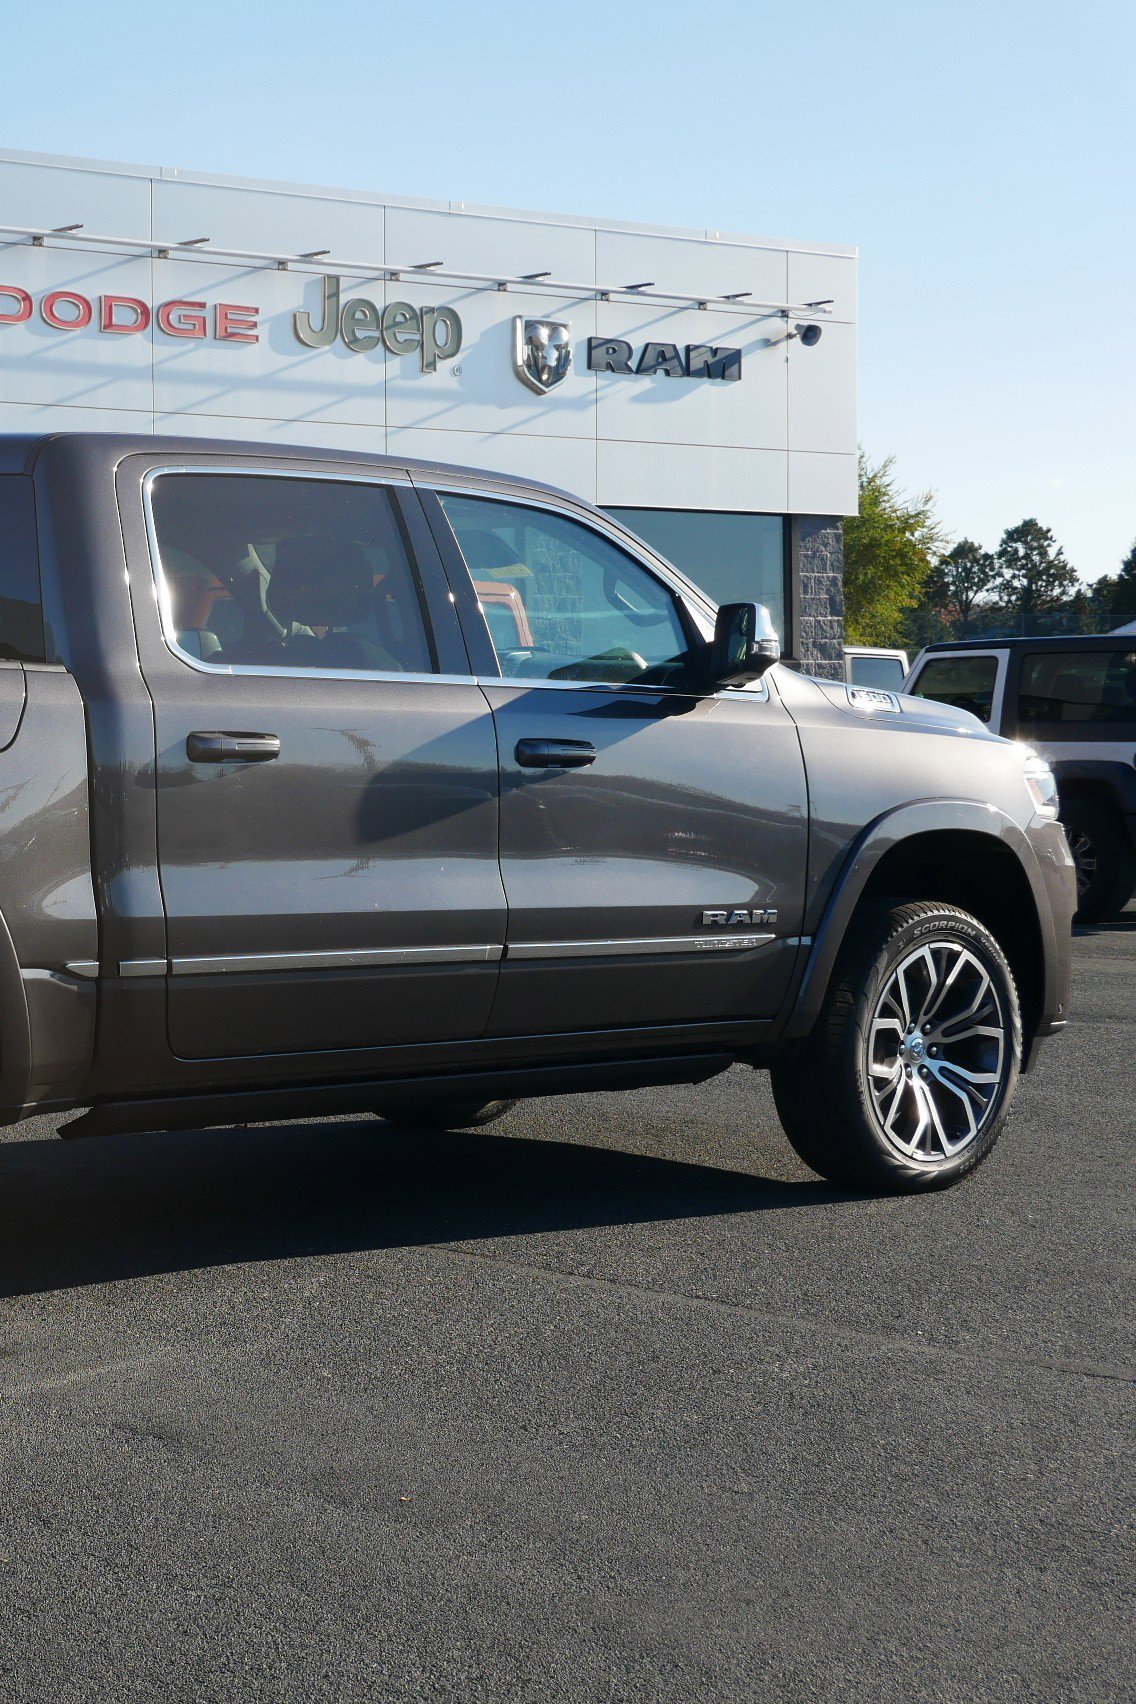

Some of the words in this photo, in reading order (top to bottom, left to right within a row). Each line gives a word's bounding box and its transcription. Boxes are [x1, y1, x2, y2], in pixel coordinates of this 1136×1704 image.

[293, 275, 463, 373] Jeep
[586, 336, 742, 381] RAM
[702, 909, 778, 925] RAM
[913, 920, 977, 938] SCORPION
